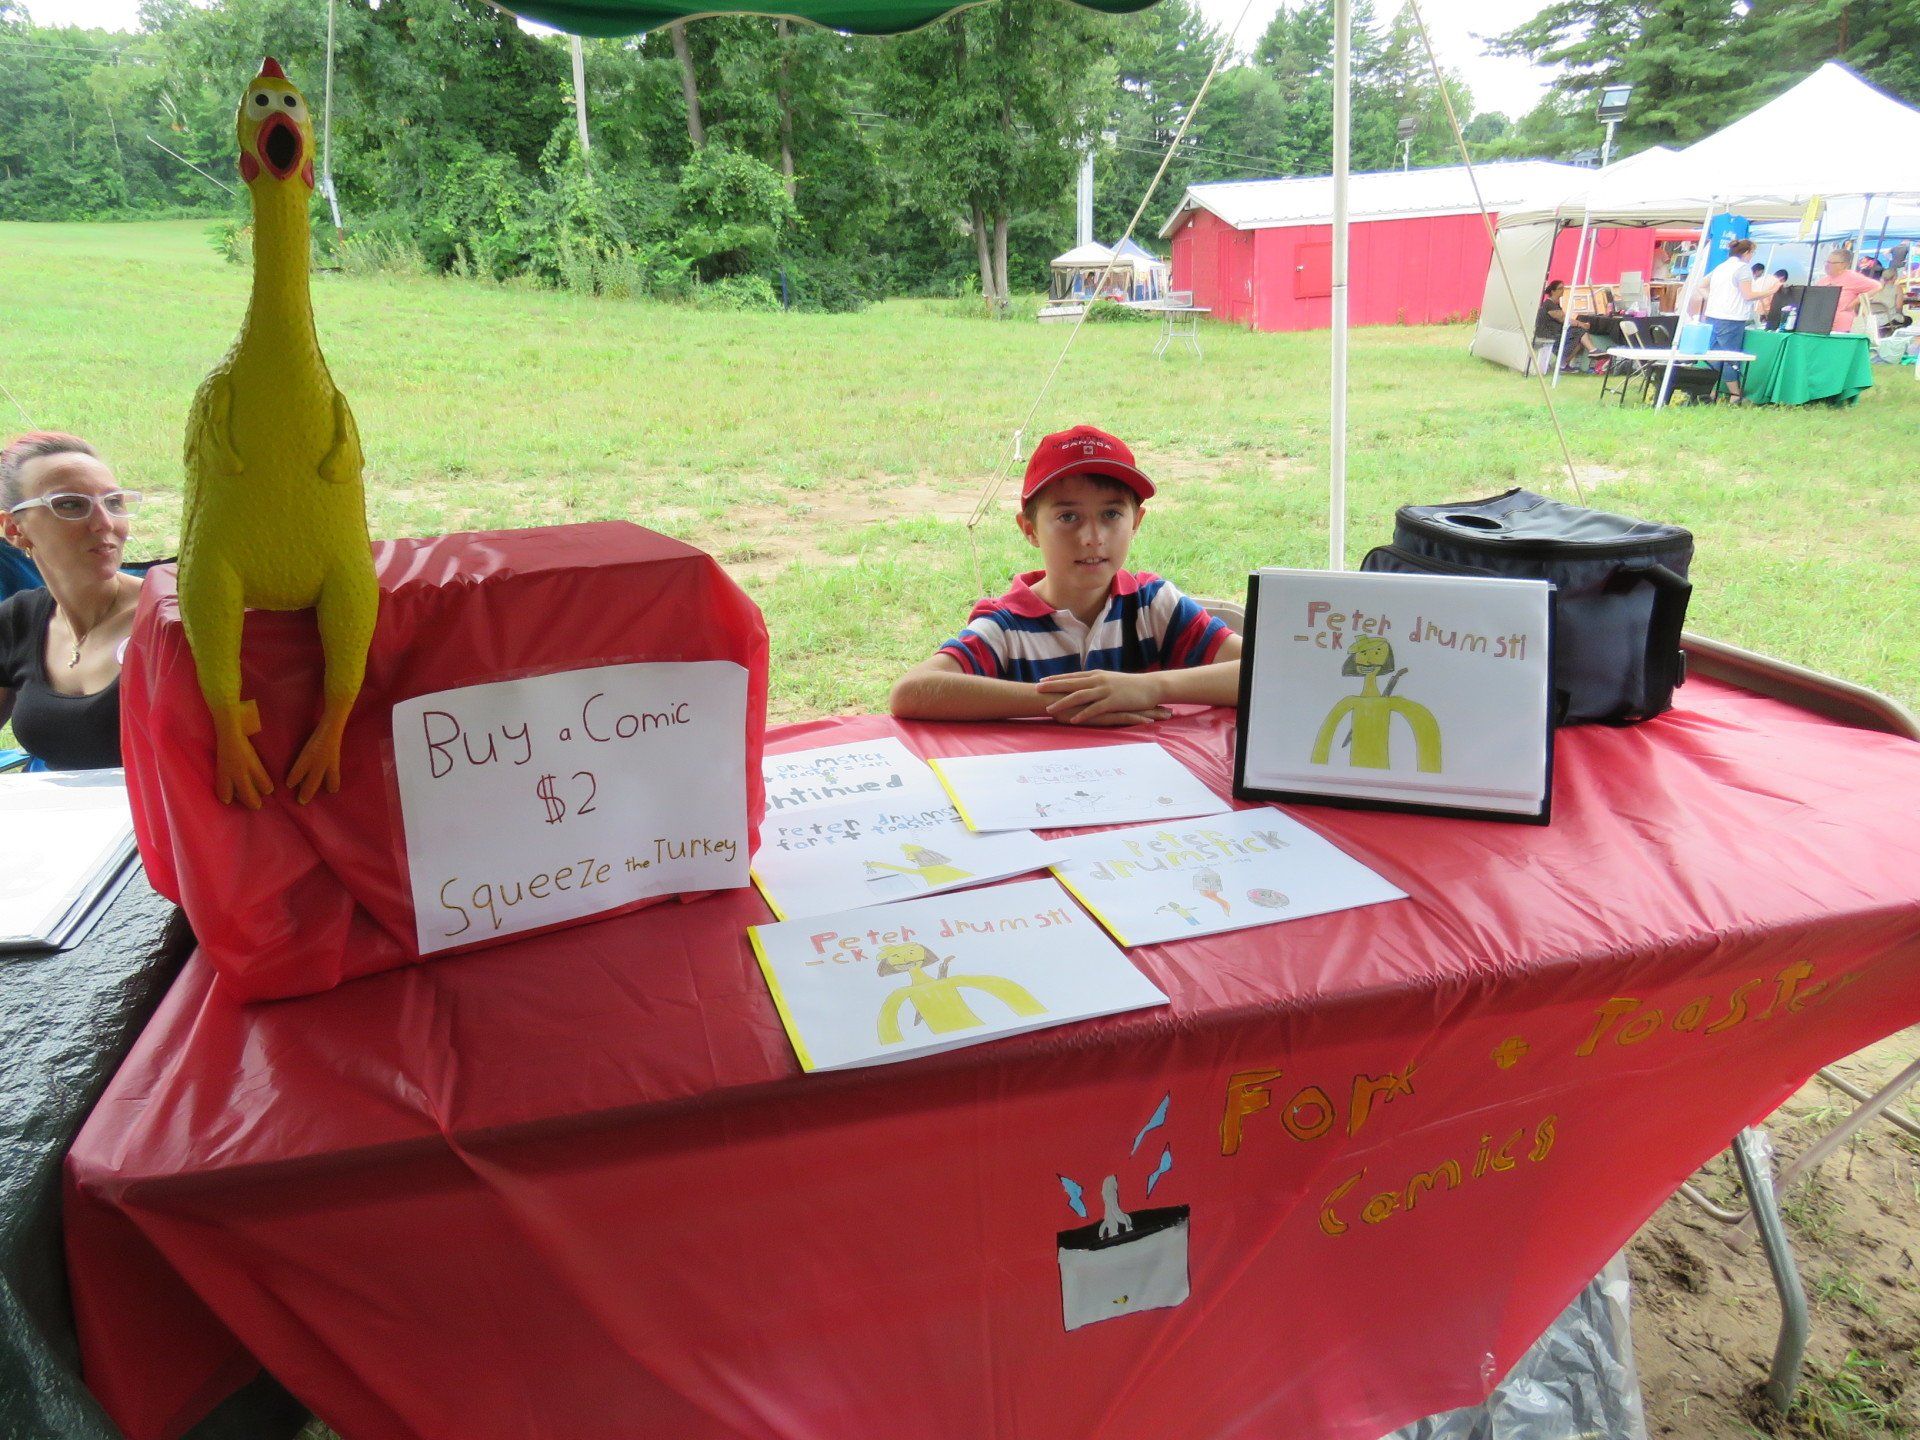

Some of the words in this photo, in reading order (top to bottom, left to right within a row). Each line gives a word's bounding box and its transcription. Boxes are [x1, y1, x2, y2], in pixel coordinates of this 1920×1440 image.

[1061, 440, 1112, 451] CANADA
[1307, 601, 1392, 636] Peter
[422, 711, 532, 779] Buy
[558, 727, 573, 742] a
[582, 693, 691, 742] Comic
[536, 771, 598, 825] $2
[625, 856, 651, 873] the
[653, 837, 738, 863] Turkey
[809, 925, 918, 955] Peter
[1218, 1060, 1418, 1157] Fork
[1317, 1111, 1559, 1236] Comics
